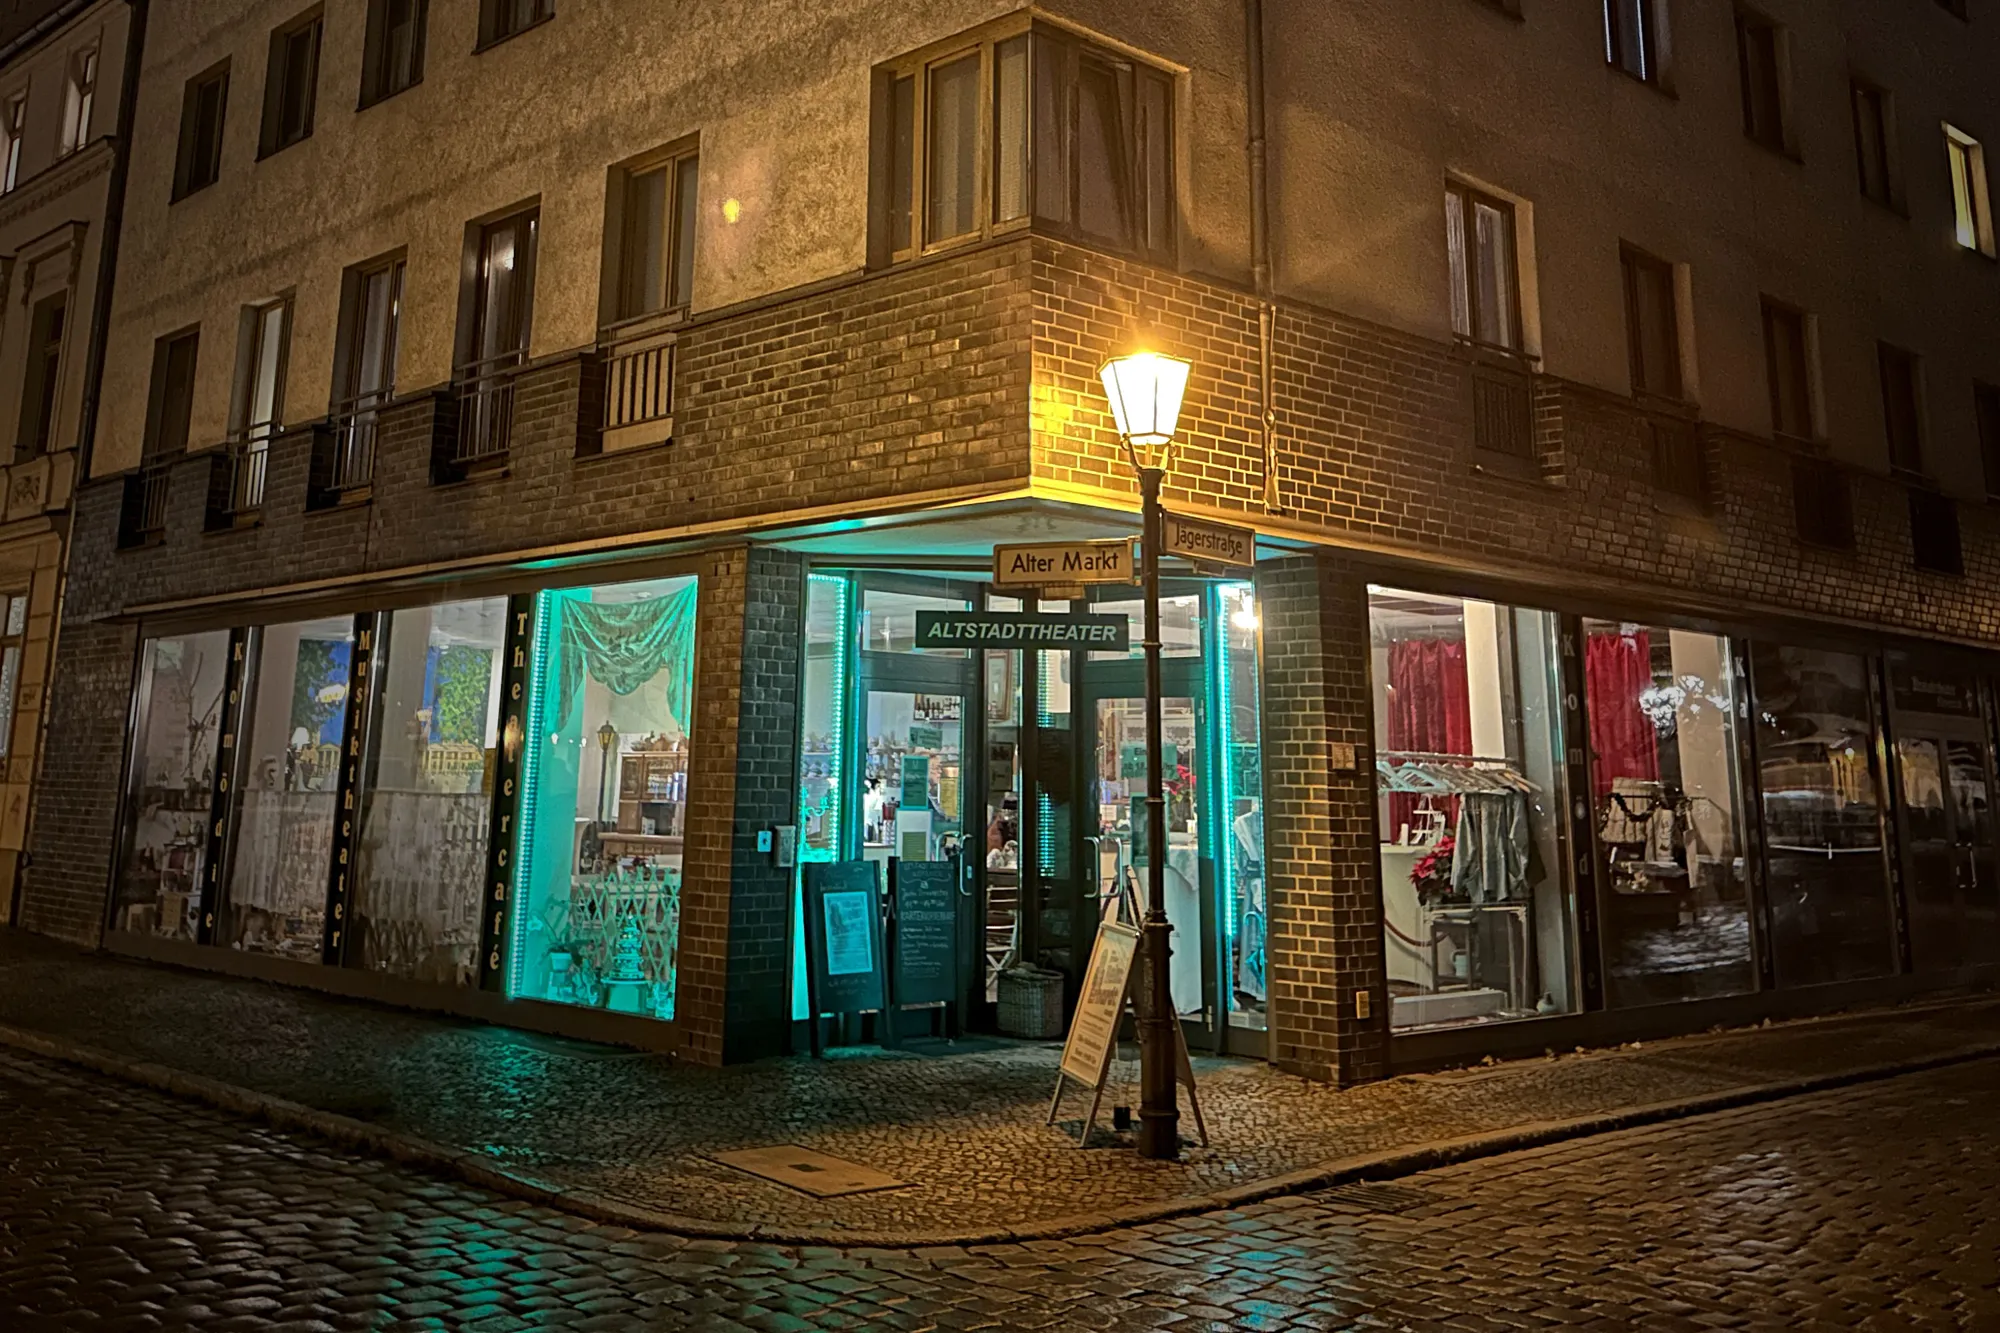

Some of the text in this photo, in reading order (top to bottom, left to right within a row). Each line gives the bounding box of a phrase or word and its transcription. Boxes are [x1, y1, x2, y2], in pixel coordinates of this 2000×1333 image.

[927, 621, 1117, 642] ALTSTADTTHEATER
[1010, 550, 1119, 574] Alter Markt
[1174, 523, 1243, 558] Jägerstraße
[205, 642, 243, 928] Komödie
[332, 629, 372, 948] Musiktheater
[489, 612, 527, 970] Theatercafé
[1564, 635, 1597, 989] Komödie
